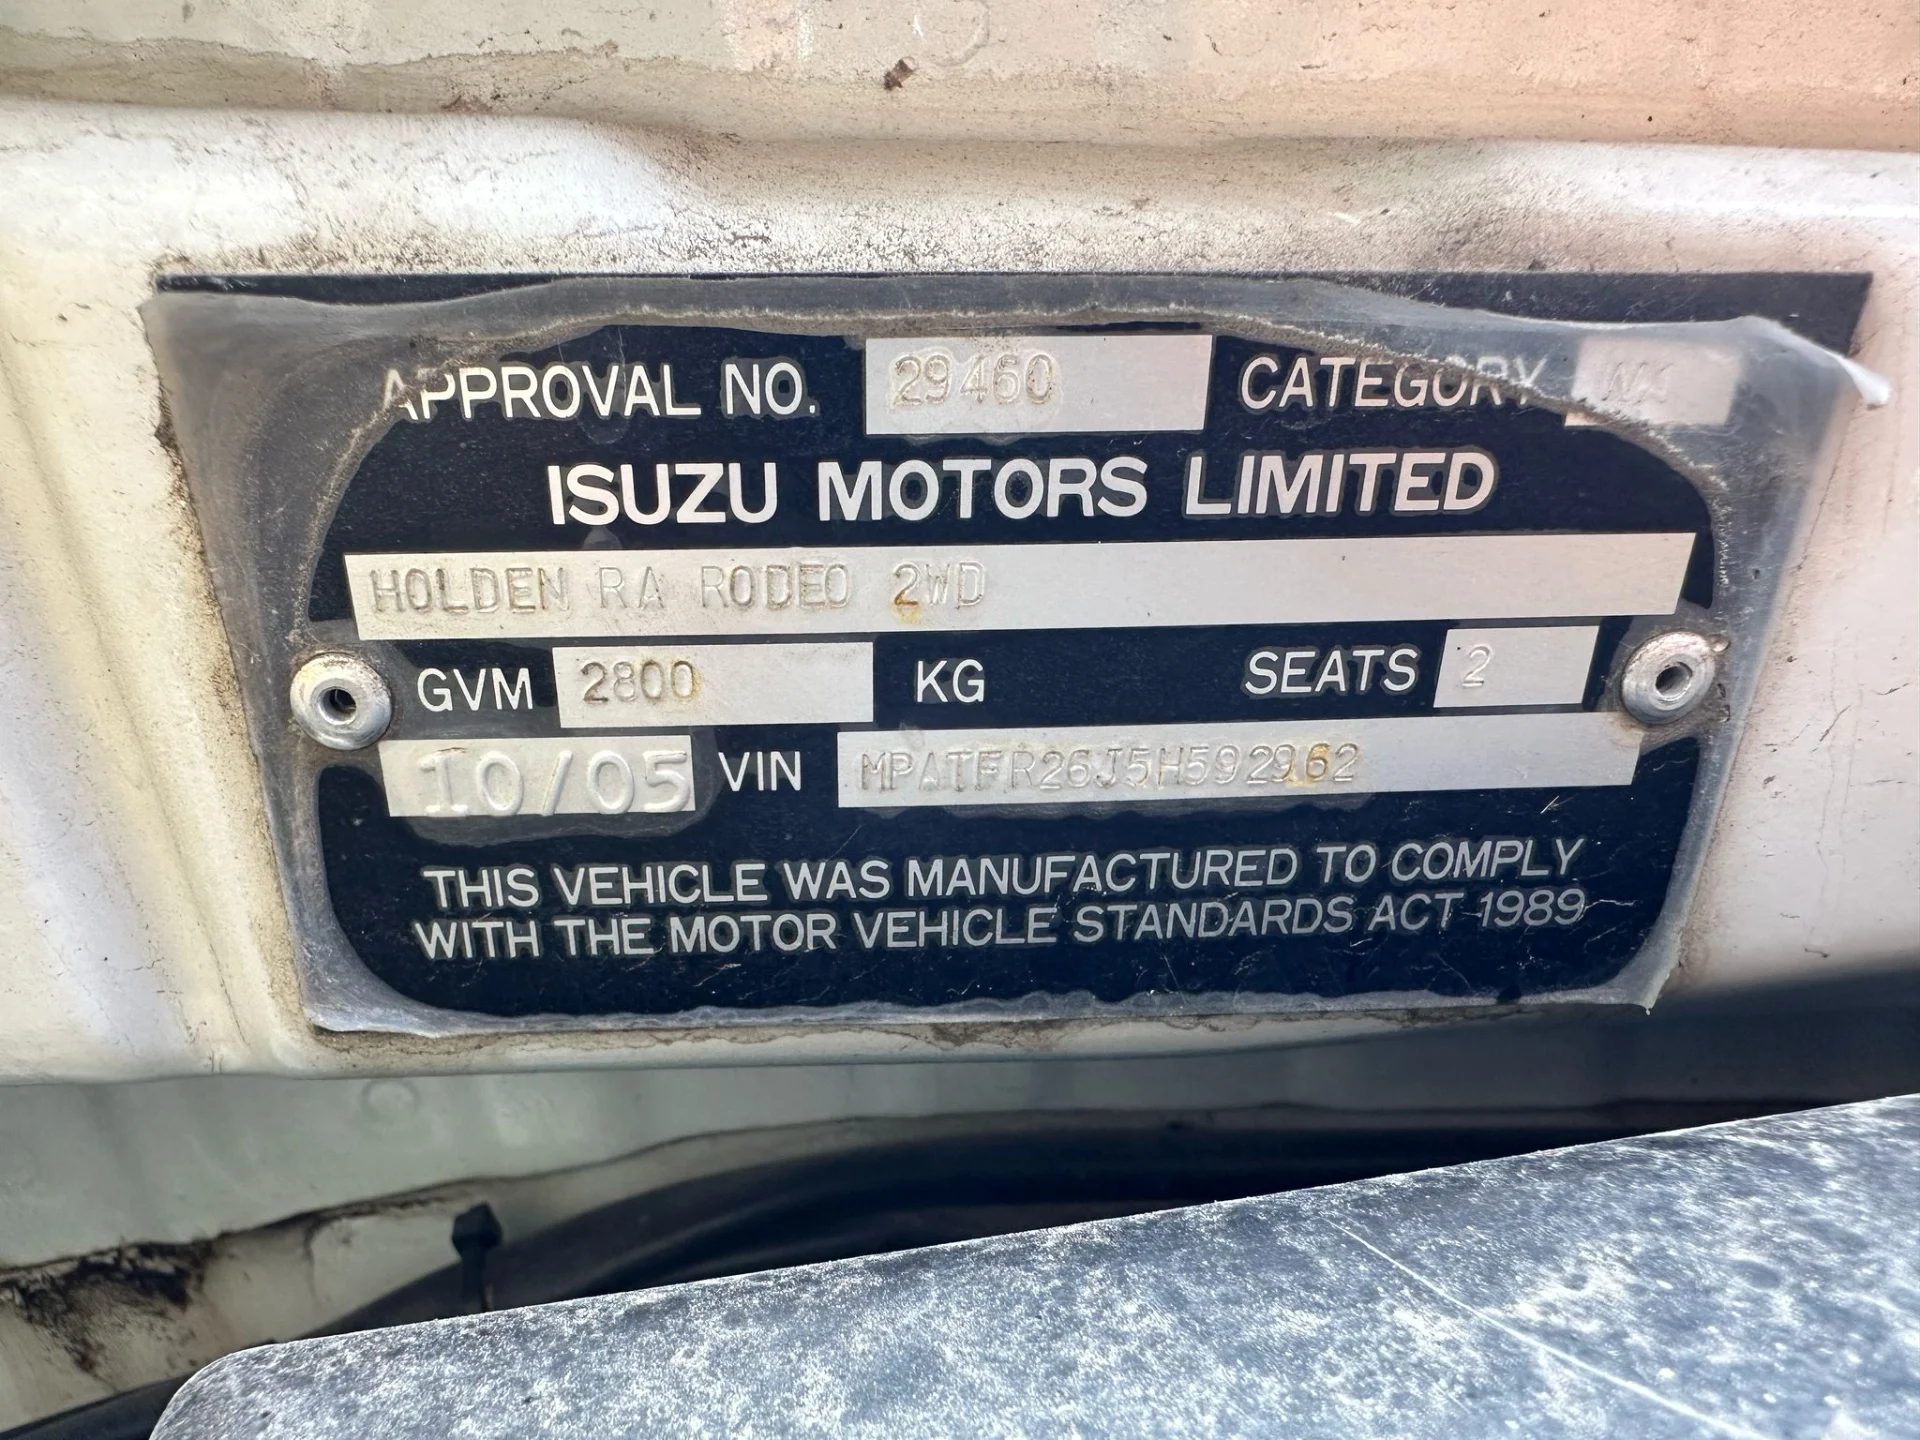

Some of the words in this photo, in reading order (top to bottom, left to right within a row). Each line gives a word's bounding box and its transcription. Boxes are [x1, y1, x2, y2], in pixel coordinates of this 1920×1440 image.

[383, 363, 701, 420] APPROVAL
[725, 362, 816, 415] NO.
[892, 354, 1057, 408] 29460
[1242, 353, 1549, 409] CATEGORY
[548, 462, 778, 525] ISUZU
[818, 457, 1148, 521] MOTORS
[1185, 452, 1496, 516] LIMITED
[370, 565, 570, 614] HOLDEN
[600, 565, 665, 609] RA
[702, 562, 851, 610] RODEO
[893, 560, 986, 608] 2WD
[417, 667, 533, 712] GVM
[583, 660, 697, 703] 2800
[916, 659, 985, 704] KG
[1245, 648, 1418, 694] SEATS
[1461, 644, 1493, 689] 2
[417, 748, 688, 818] 10/05
[717, 750, 801, 792] VIN
[860, 742, 1359, 791] MPATFR26J5H592962
[423, 867, 540, 908] THIS
[553, 863, 768, 905] VEHICLE
[783, 860, 890, 900] WAS
[908, 848, 1298, 897] MANUFACTURED
[1316, 844, 1377, 883] TO
[1391, 838, 1585, 881] COMPLY
[414, 919, 540, 959] WITH
[554, 917, 654, 957] THE
[670, 912, 837, 956] MOTOR
[853, 907, 1058, 949] VEHICLE
[1074, 896, 1355, 943] STANDARDS
[1368, 892, 1465, 931] ACT
[1479, 888, 1587, 927] 1989
